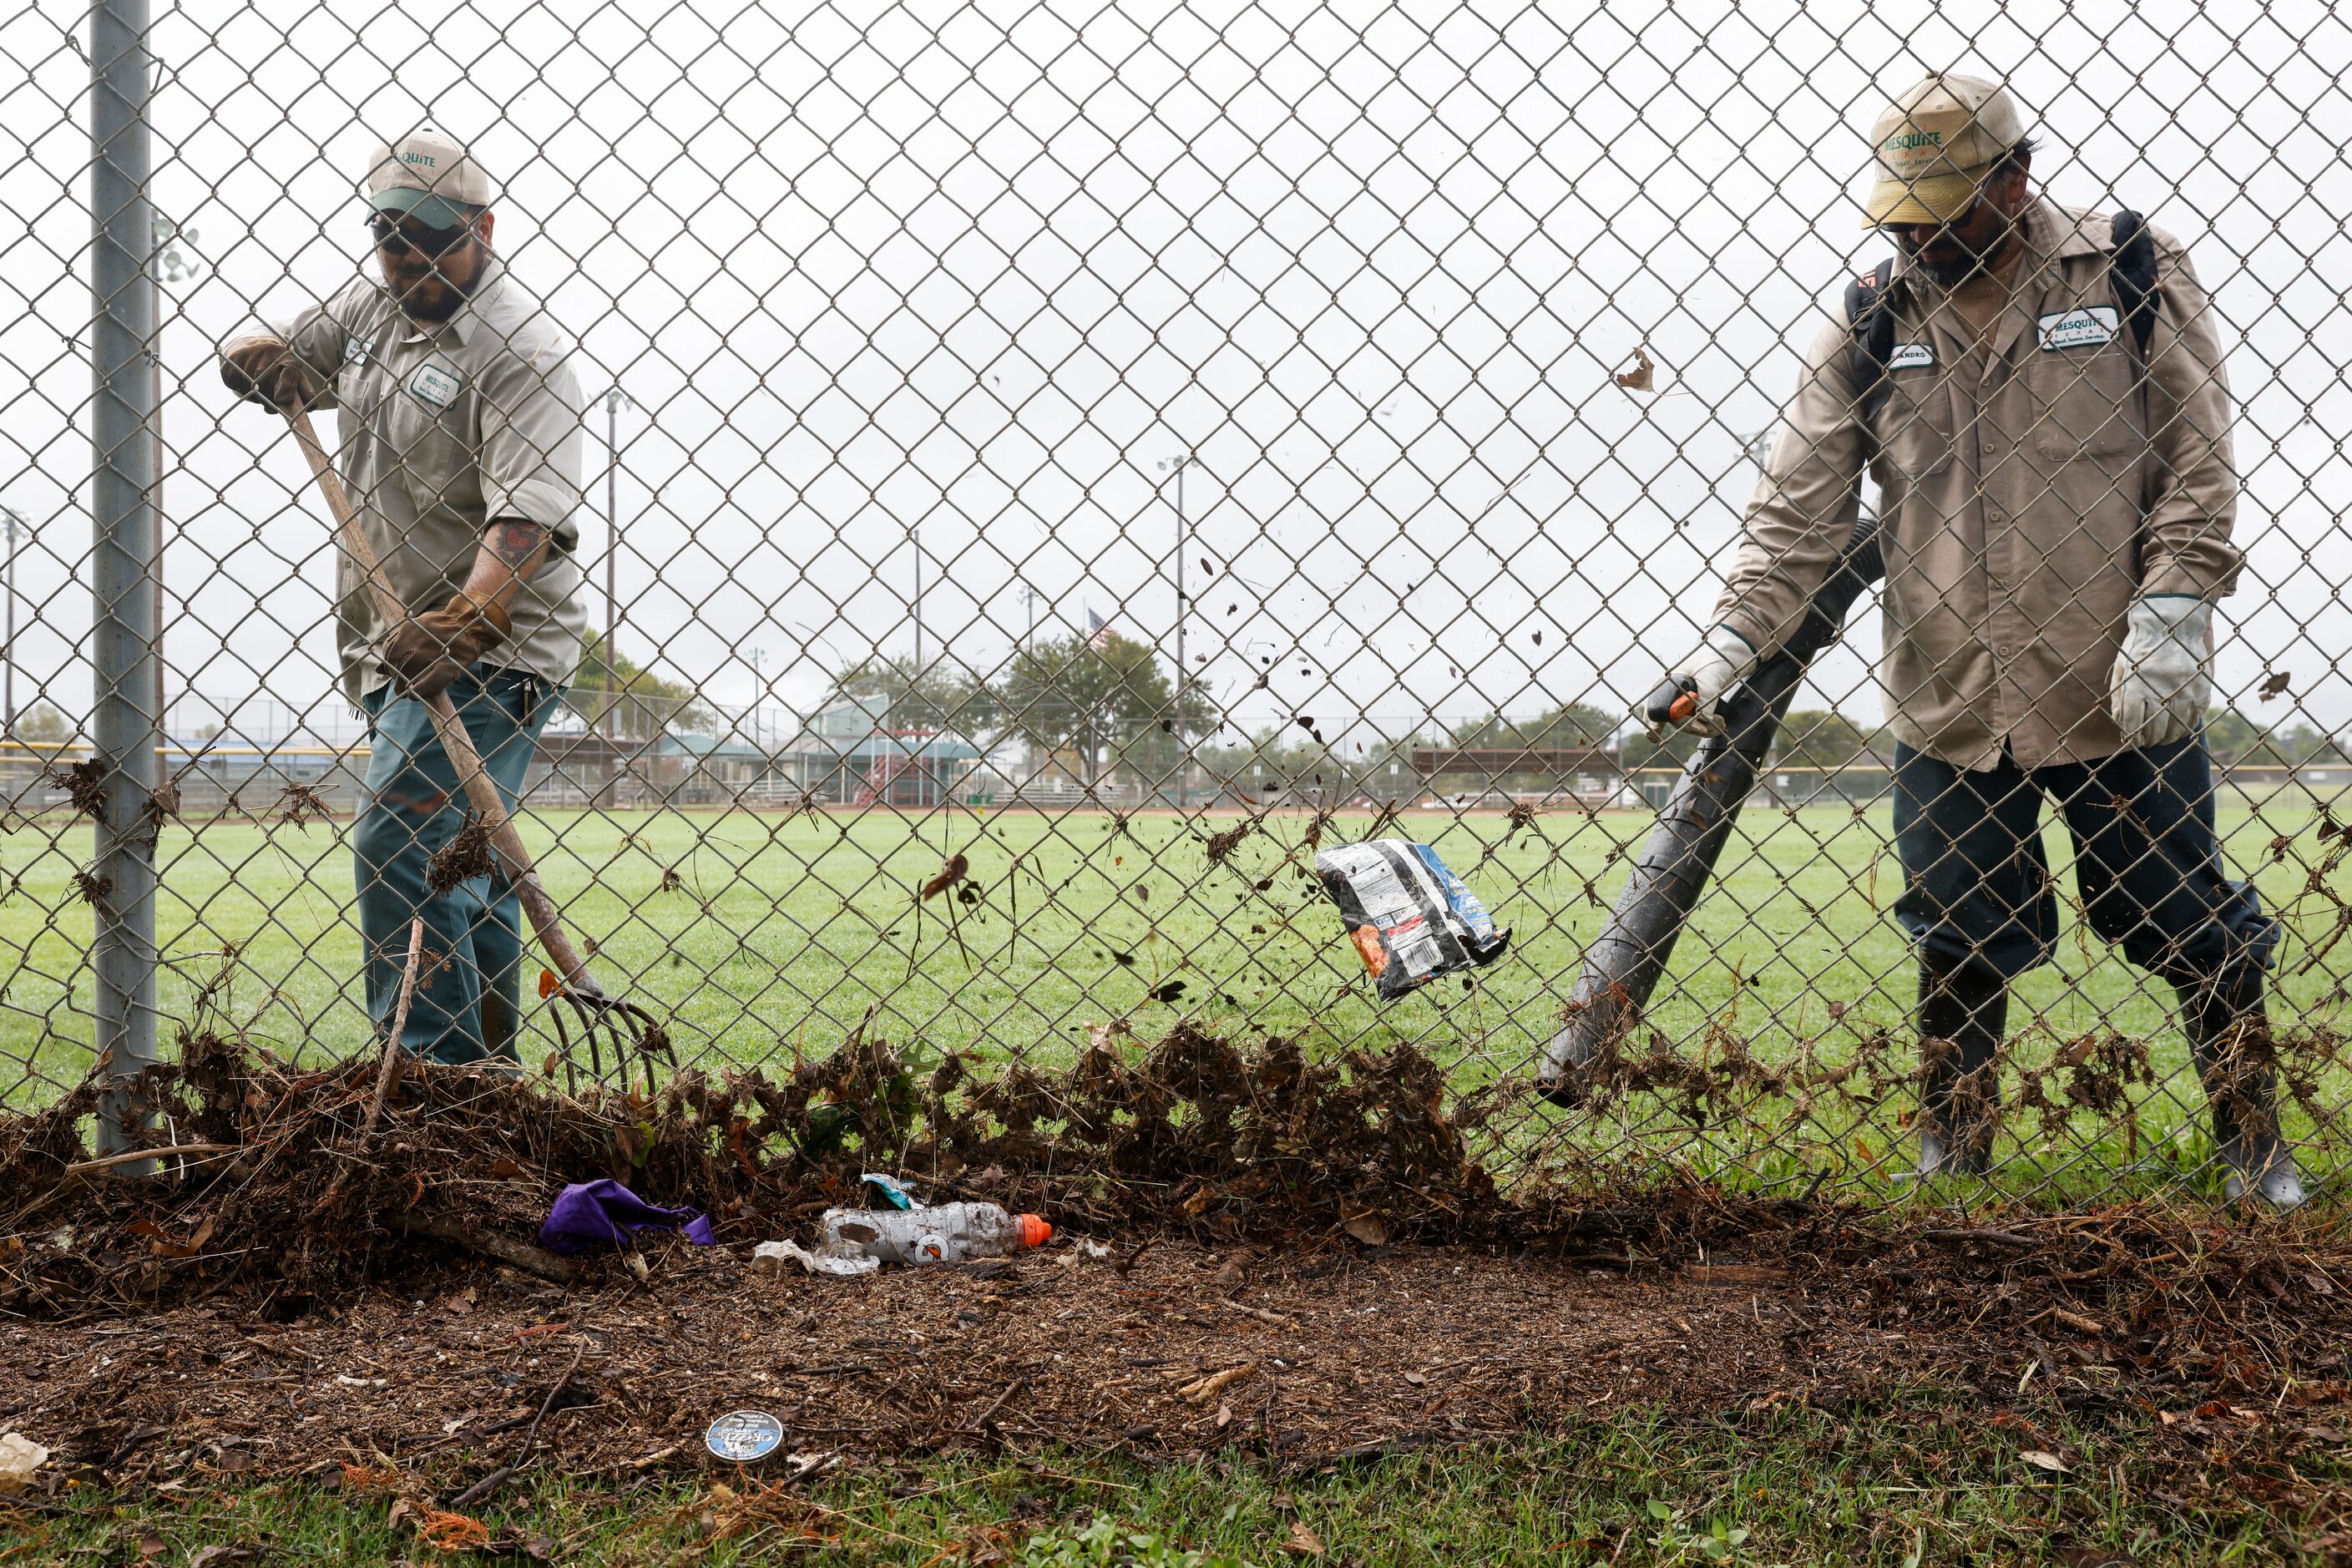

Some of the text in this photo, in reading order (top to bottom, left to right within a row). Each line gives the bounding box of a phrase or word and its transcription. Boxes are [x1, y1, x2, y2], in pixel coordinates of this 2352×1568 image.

[1884, 132, 1941, 151] MESQUITE
[2054, 328, 2104, 339] TEXAS
[426, 374, 450, 392] MESQUITE
